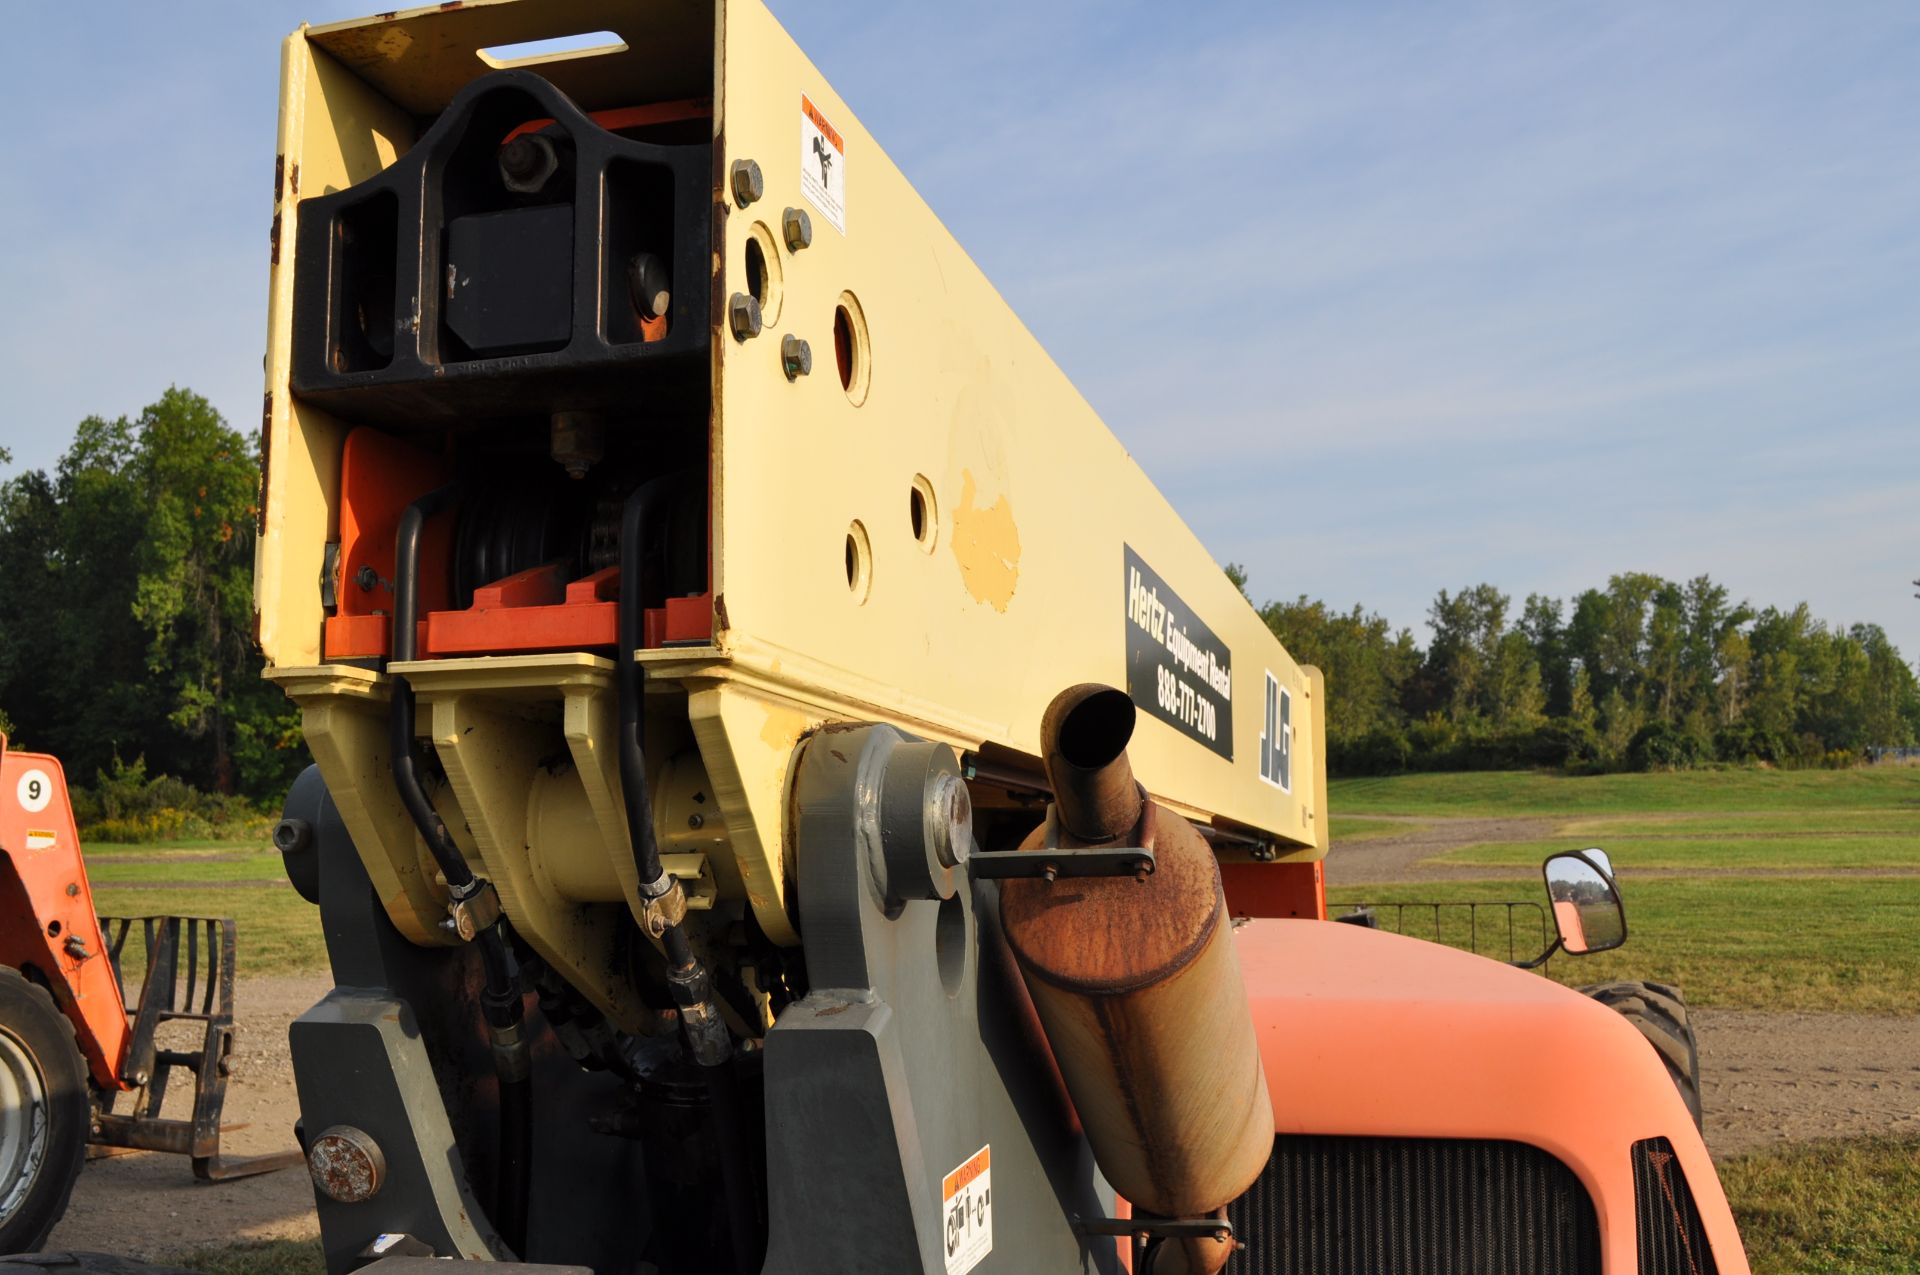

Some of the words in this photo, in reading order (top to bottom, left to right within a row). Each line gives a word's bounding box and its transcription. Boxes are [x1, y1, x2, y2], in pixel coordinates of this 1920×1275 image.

[1128, 566, 1166, 645] Hertz
[1166, 611, 1210, 683] Equipment
[1209, 652, 1231, 701] Rental
[1157, 664, 1216, 742] 888-777-2700
[1259, 668, 1291, 795] JLG
[28, 780, 42, 800] 9
[959, 1154, 981, 1188] WARNING
